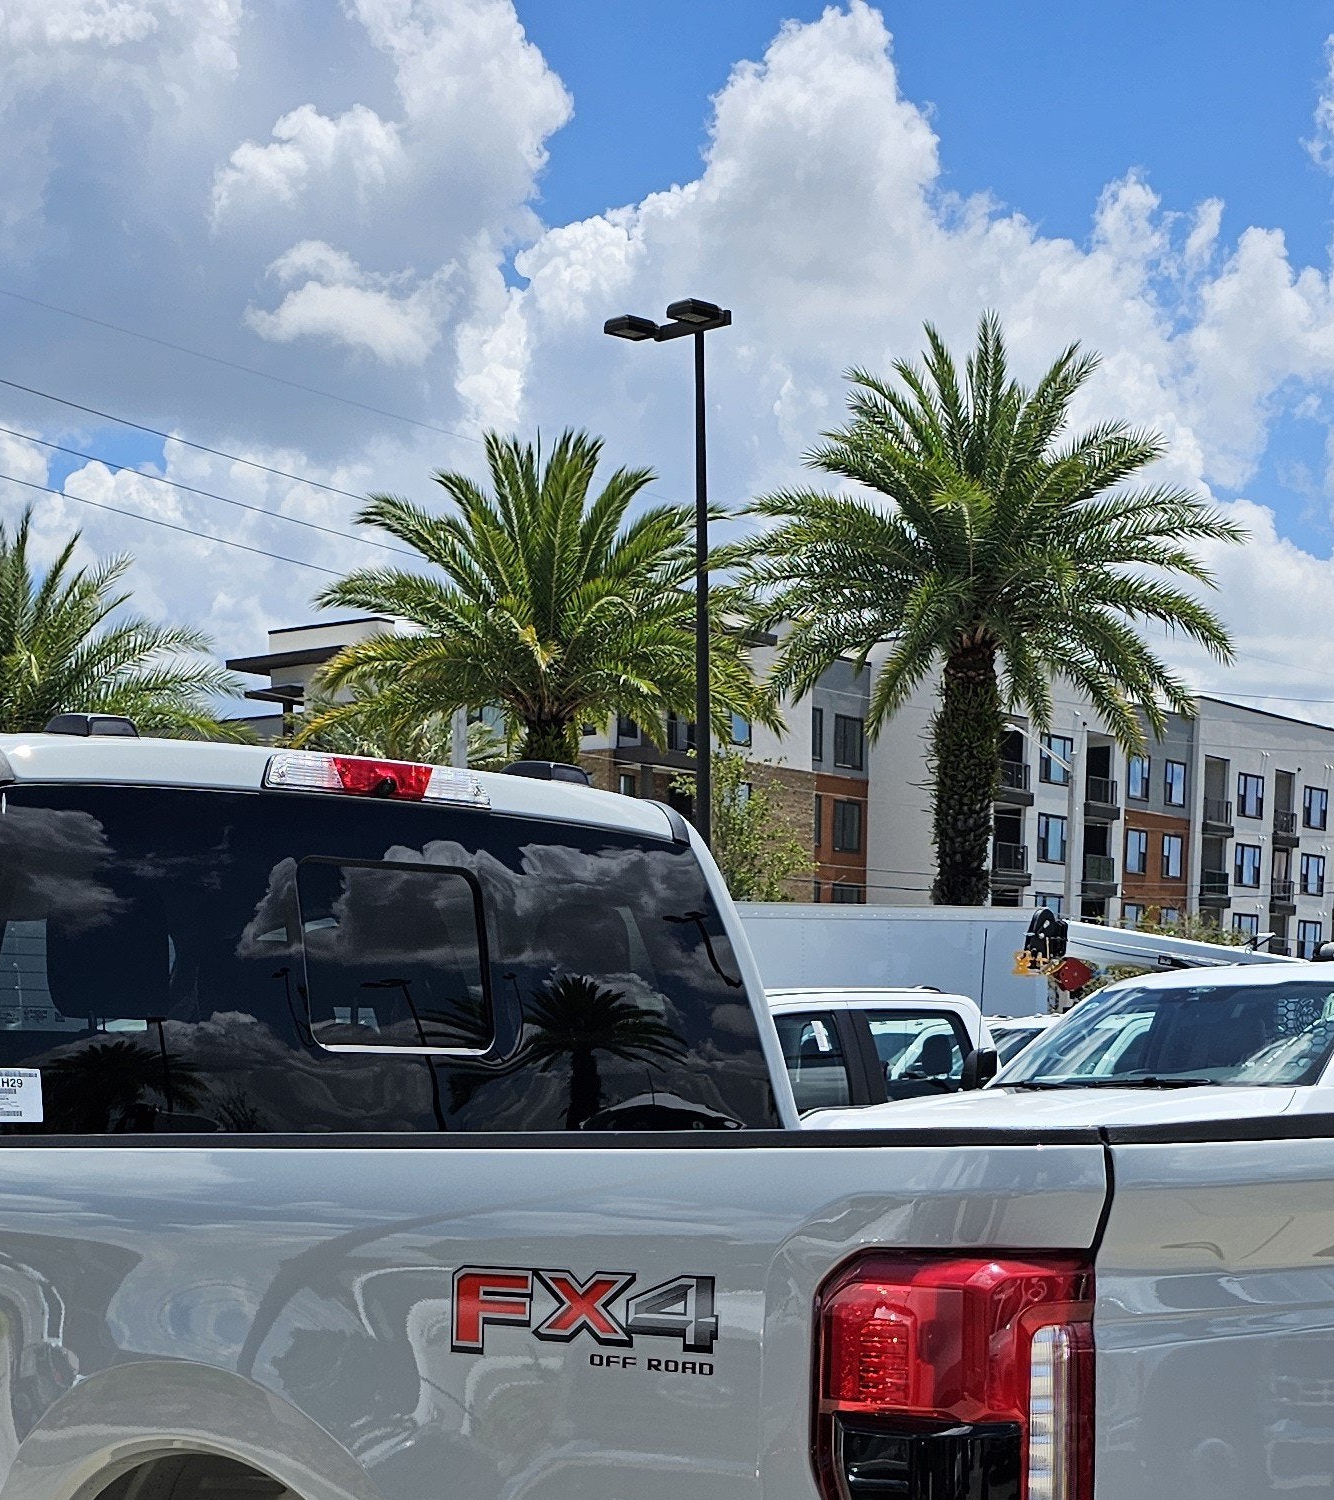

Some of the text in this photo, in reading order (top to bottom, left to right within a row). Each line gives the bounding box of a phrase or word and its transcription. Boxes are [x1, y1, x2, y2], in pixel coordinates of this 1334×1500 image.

[450, 1264, 719, 1354] FX4
[589, 1353, 714, 1376] OFF ROAD
